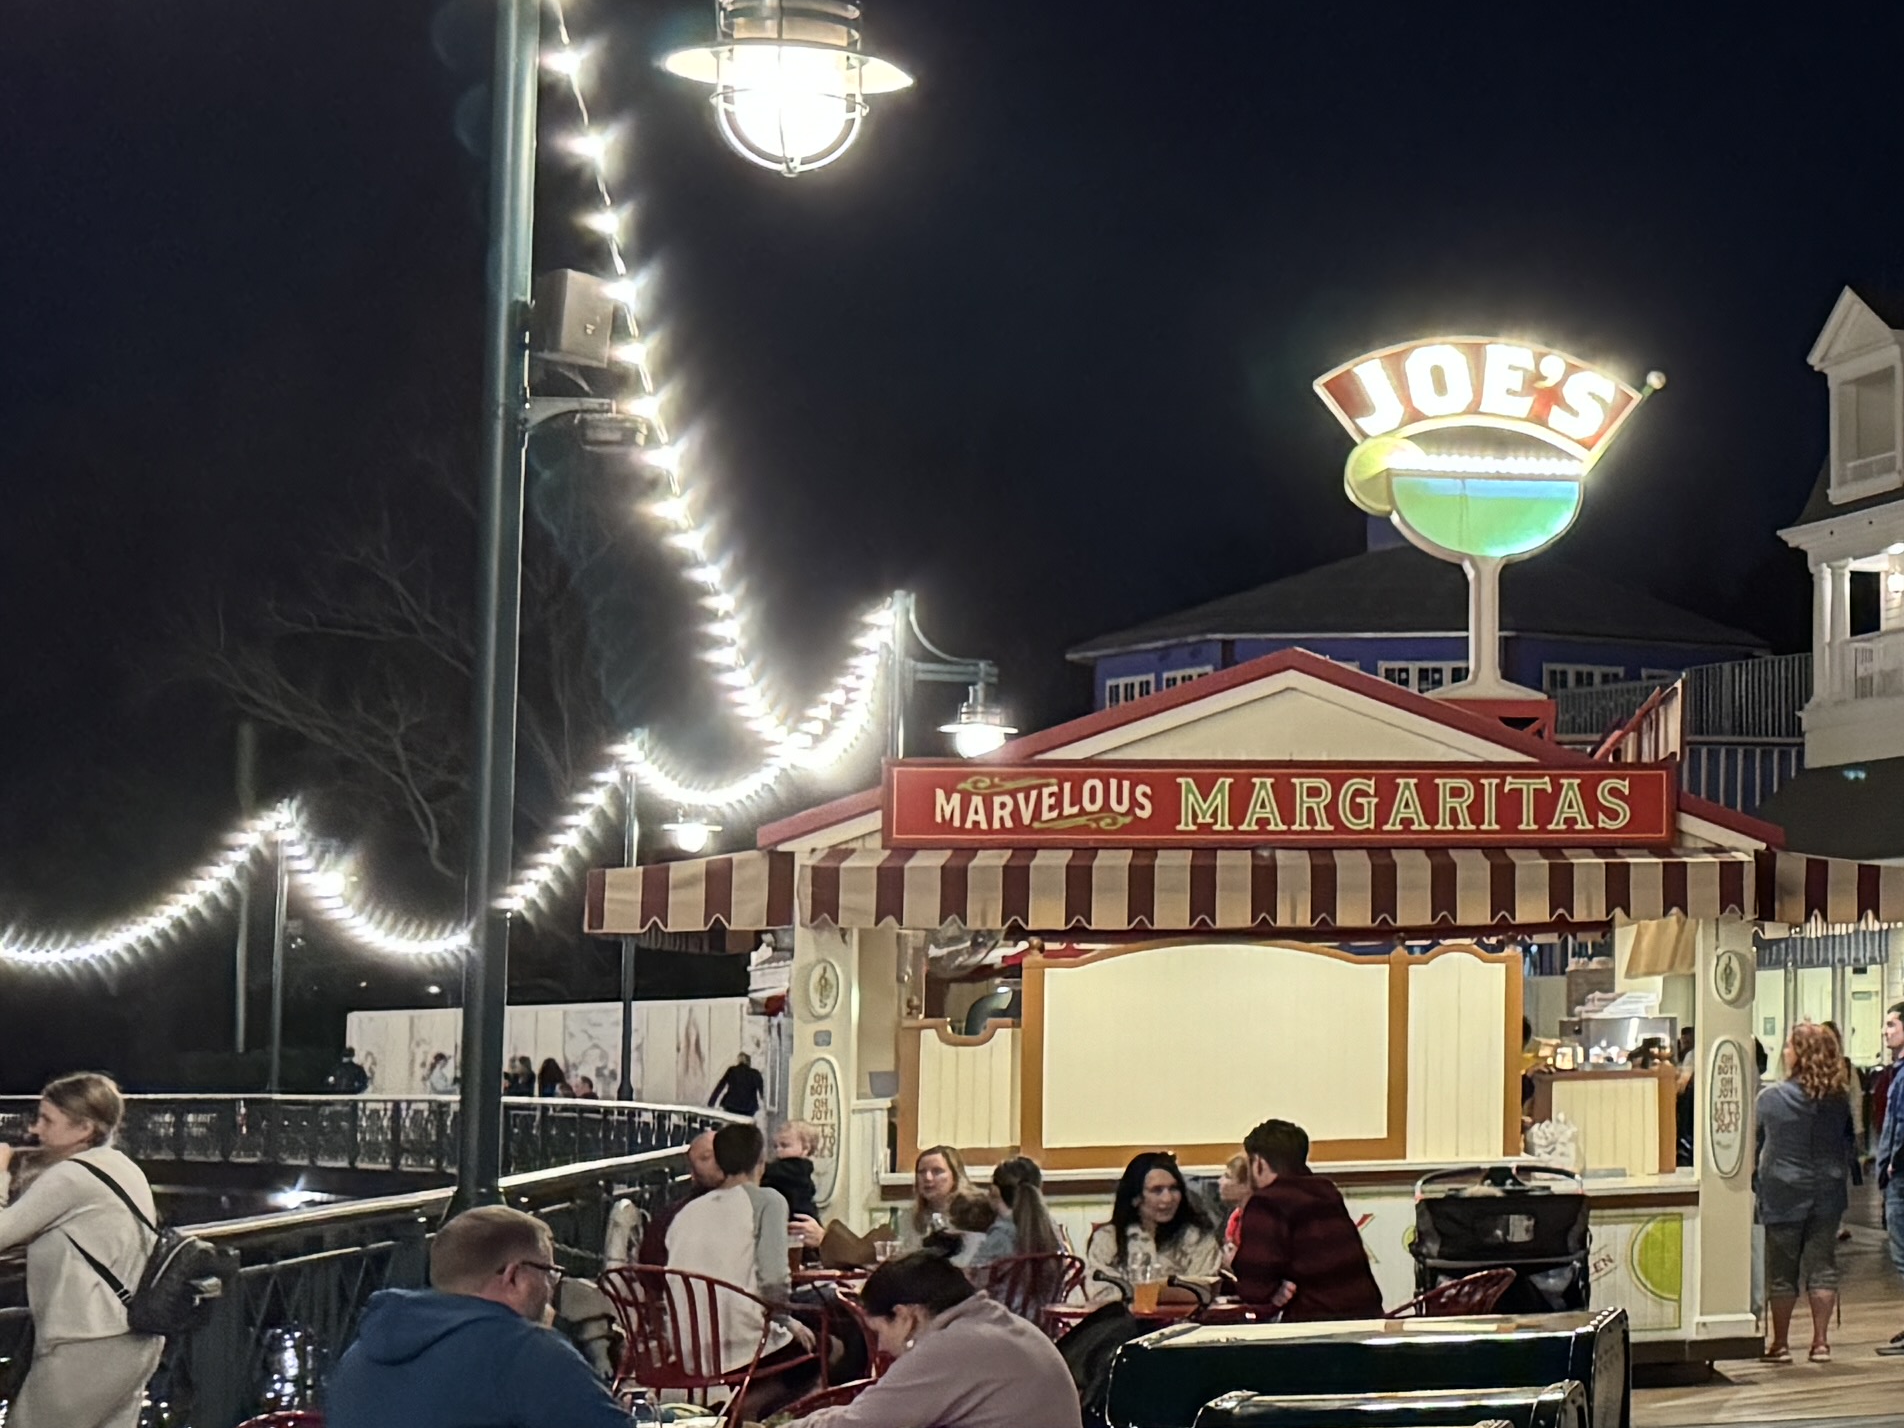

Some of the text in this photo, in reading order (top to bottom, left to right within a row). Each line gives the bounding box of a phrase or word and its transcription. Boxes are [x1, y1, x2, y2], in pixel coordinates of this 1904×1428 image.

[1352, 343, 1616, 442] JOE'S
[935, 776, 1632, 832] MARVELOUS MARGARITAS
[814, 1073, 828, 1085] OH
[814, 1098, 828, 1111] OH
